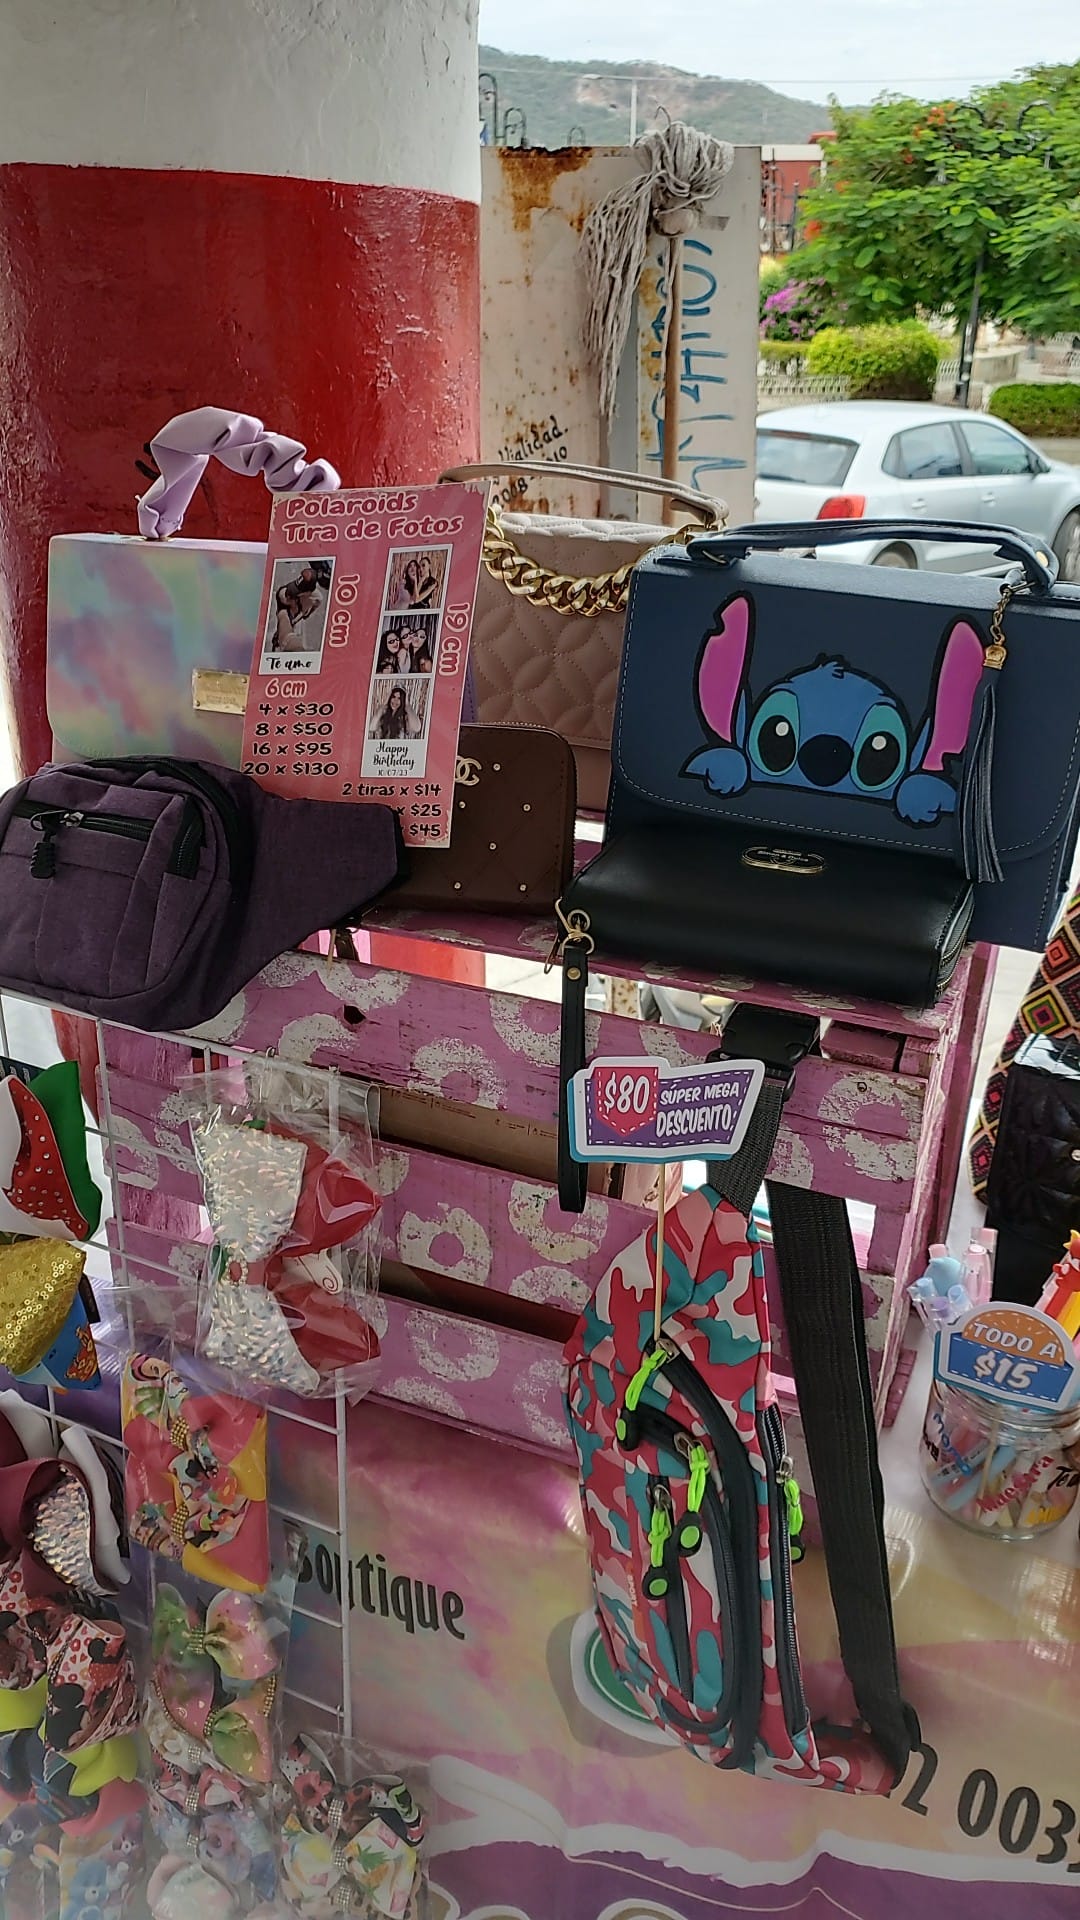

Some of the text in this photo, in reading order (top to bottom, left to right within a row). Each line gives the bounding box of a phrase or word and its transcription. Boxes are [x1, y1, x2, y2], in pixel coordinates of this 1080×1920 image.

[286, 493, 417, 518] Polaroids
[283, 515, 464, 543] Tira de Fotos
[329, 574, 360, 647] 10 cm
[439, 602, 470, 676] 19 cm
[266, 657, 312, 671] Te amo
[265, 678, 307, 697] 6 cm
[259, 703, 334, 716] 4 x $30
[255, 722, 333, 736] 8 x $50
[253, 742, 332, 756] 16 x $95
[375, 741, 409, 758] Happy
[243, 762, 339, 776] 20 x $130
[373, 753, 415, 771] Birthday
[342, 783, 441, 796] 2 tiras x $14
[410, 803, 441, 817] $25
[409, 823, 441, 837] $45
[604, 1071, 650, 1114] $80
[659, 1082, 740, 1106] SÚPER MEGA
[656, 1103, 733, 1139] DESCUENTO
[973, 1322, 1058, 1359] TODO A
[973, 1350, 1039, 1389] $15
